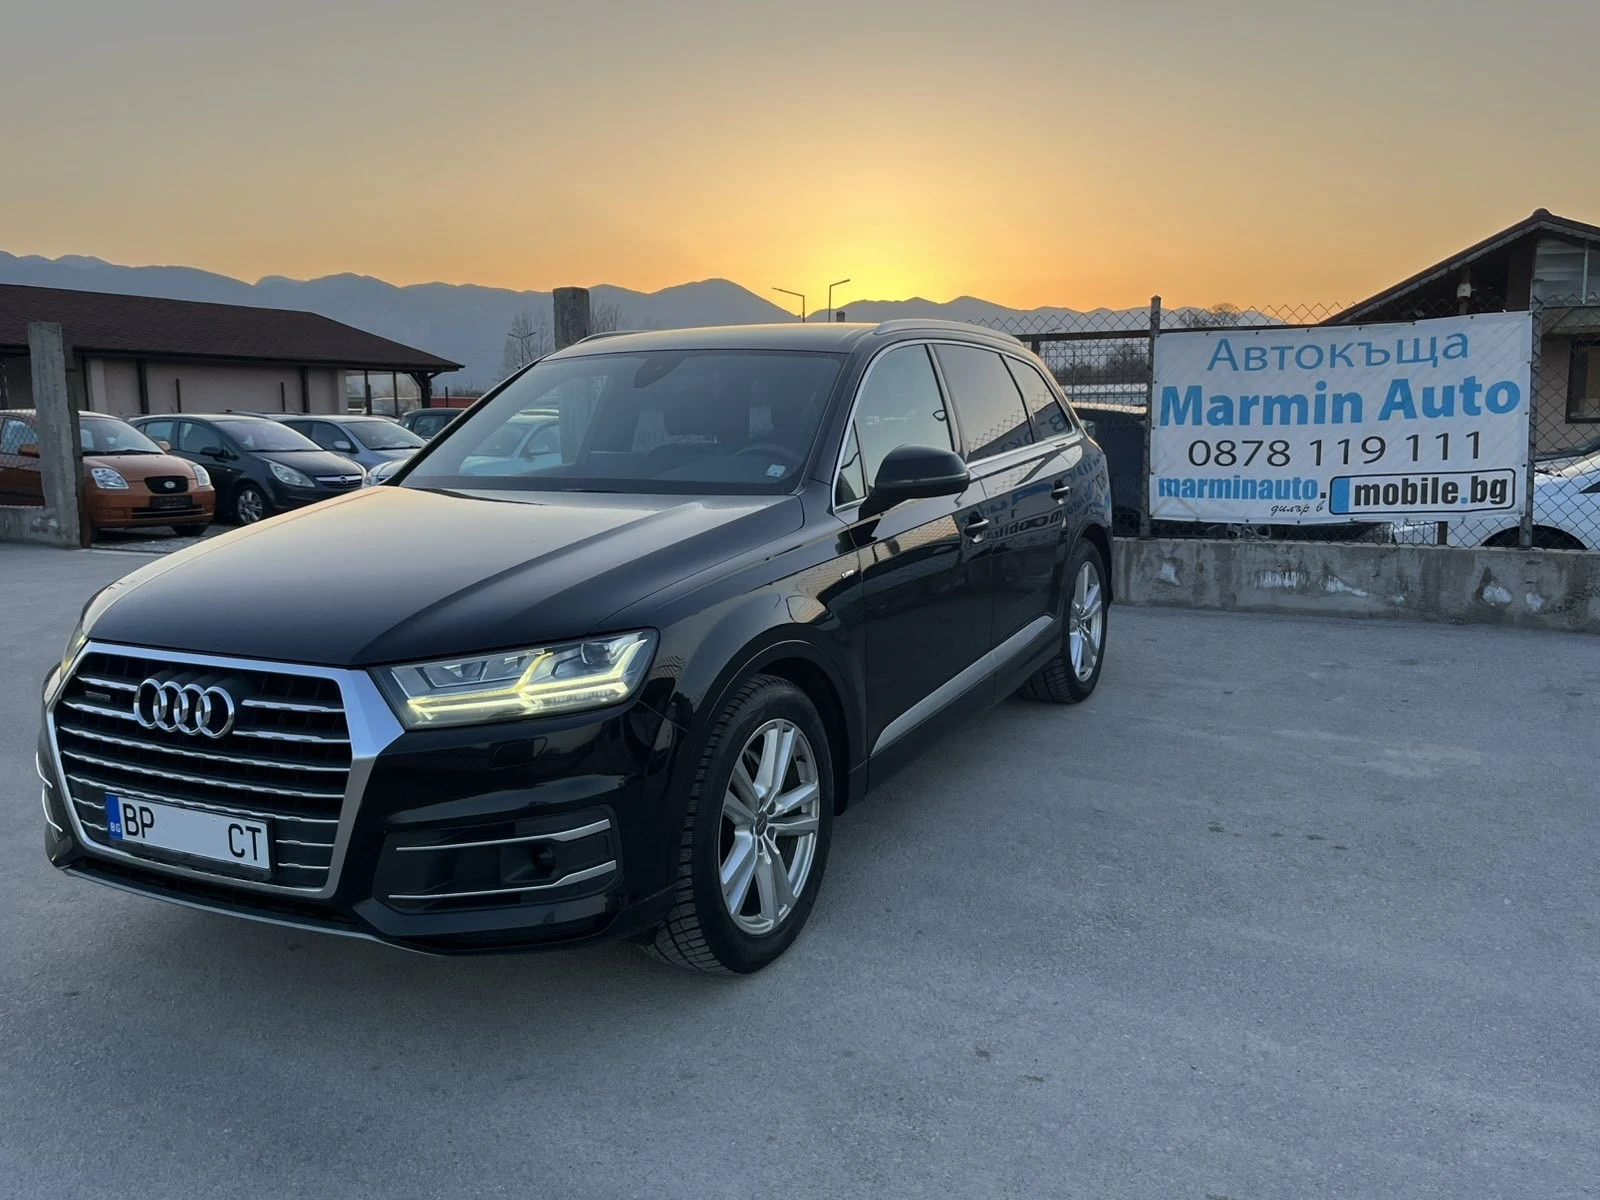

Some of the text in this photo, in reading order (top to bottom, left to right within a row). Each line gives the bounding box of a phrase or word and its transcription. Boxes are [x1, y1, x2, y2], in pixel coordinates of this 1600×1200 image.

[1207, 332, 1468, 372] Автокъща
[1159, 375, 1521, 427] Marmin Auto
[1188, 431, 1480, 467] 0878 119 111
[1353, 475, 1508, 506] mobile.bg
[110, 821, 121, 833] BG
[122, 802, 262, 861] BP CT
